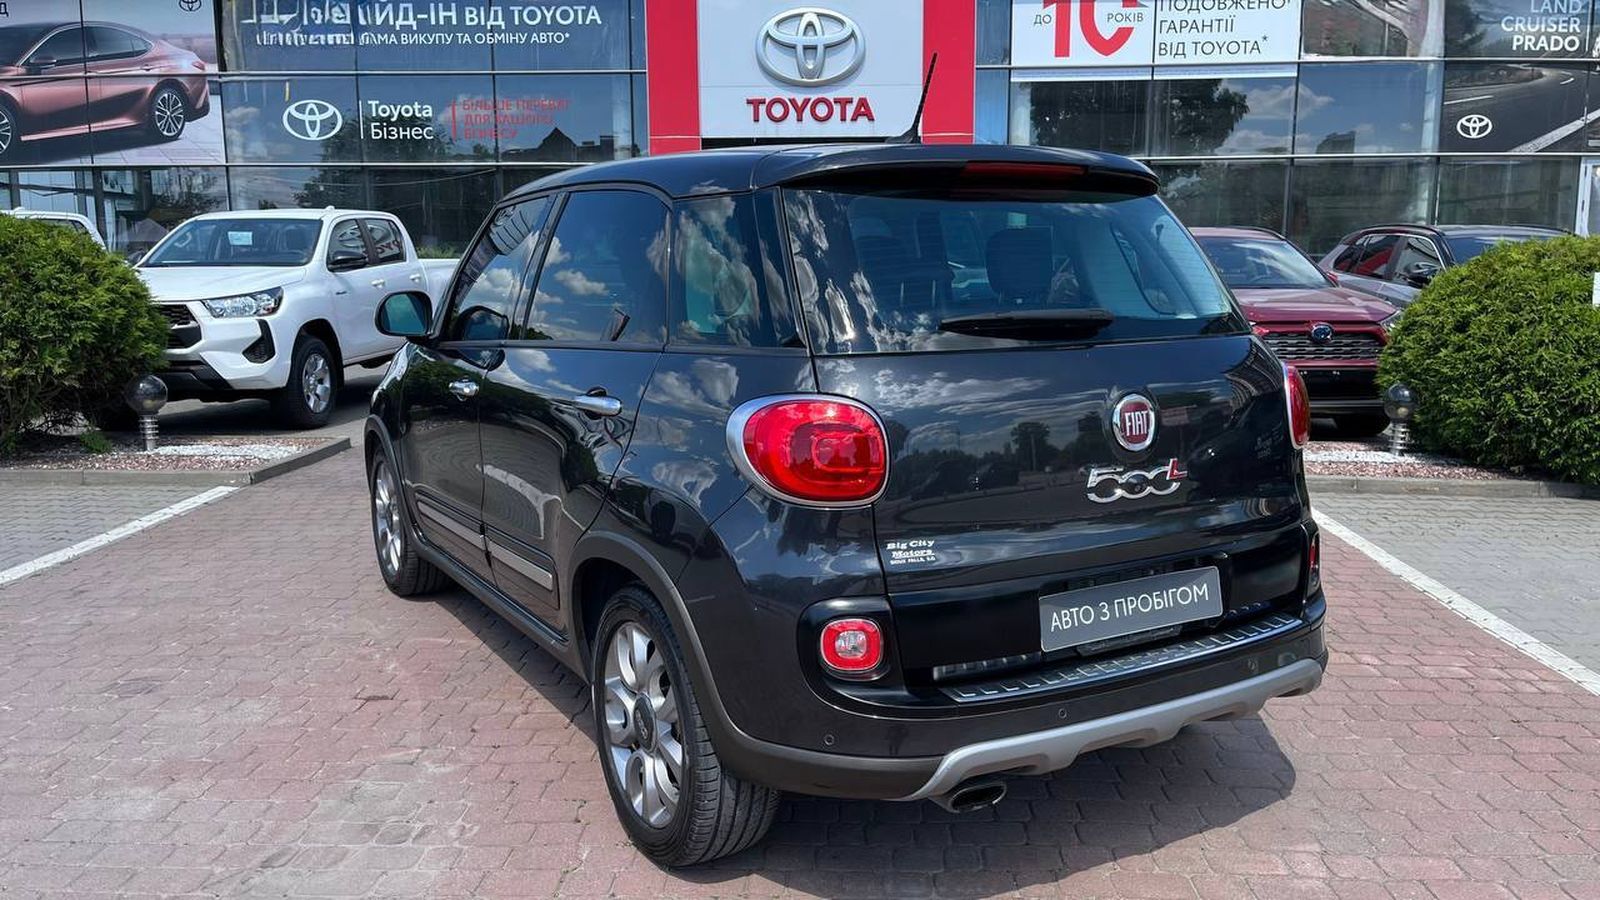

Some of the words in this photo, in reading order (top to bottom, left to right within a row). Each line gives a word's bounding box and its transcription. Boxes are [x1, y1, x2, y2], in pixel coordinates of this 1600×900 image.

[357, 0, 458, 30] ЙД-ІН
[464, 7, 506, 29] ВІД
[509, 5, 602, 25] TOYOTA
[1160, 0, 1291, 13] ПОДОВЖЕНО
[1530, 0, 1582, 13] LAND
[1033, 14, 1052, 25] ДО
[1107, 12, 1144, 23] РОКІВ
[1158, 14, 1236, 34] ГАРАНТІЇ
[1501, 15, 1581, 33] CRUISER
[401, 33, 453, 44] ВИКУПУ
[456, 33, 472, 44] ТА
[474, 32, 527, 44] ОБМІНУ
[1512, 34, 1580, 52] PRADO
[1158, 41, 1187, 58] ВІД
[368, 100, 433, 121] Toyota
[746, 97, 875, 122] TOYOTA
[371, 122, 434, 140] Бізнес
[1124, 410, 1149, 436] FIAT
[886, 541, 908, 550] Big
[909, 539, 935, 548] City
[891, 549, 935, 560] Motors
[1051, 605, 1095, 632] АВТО
[1114, 583, 1210, 618] ПРОБІГОМ
